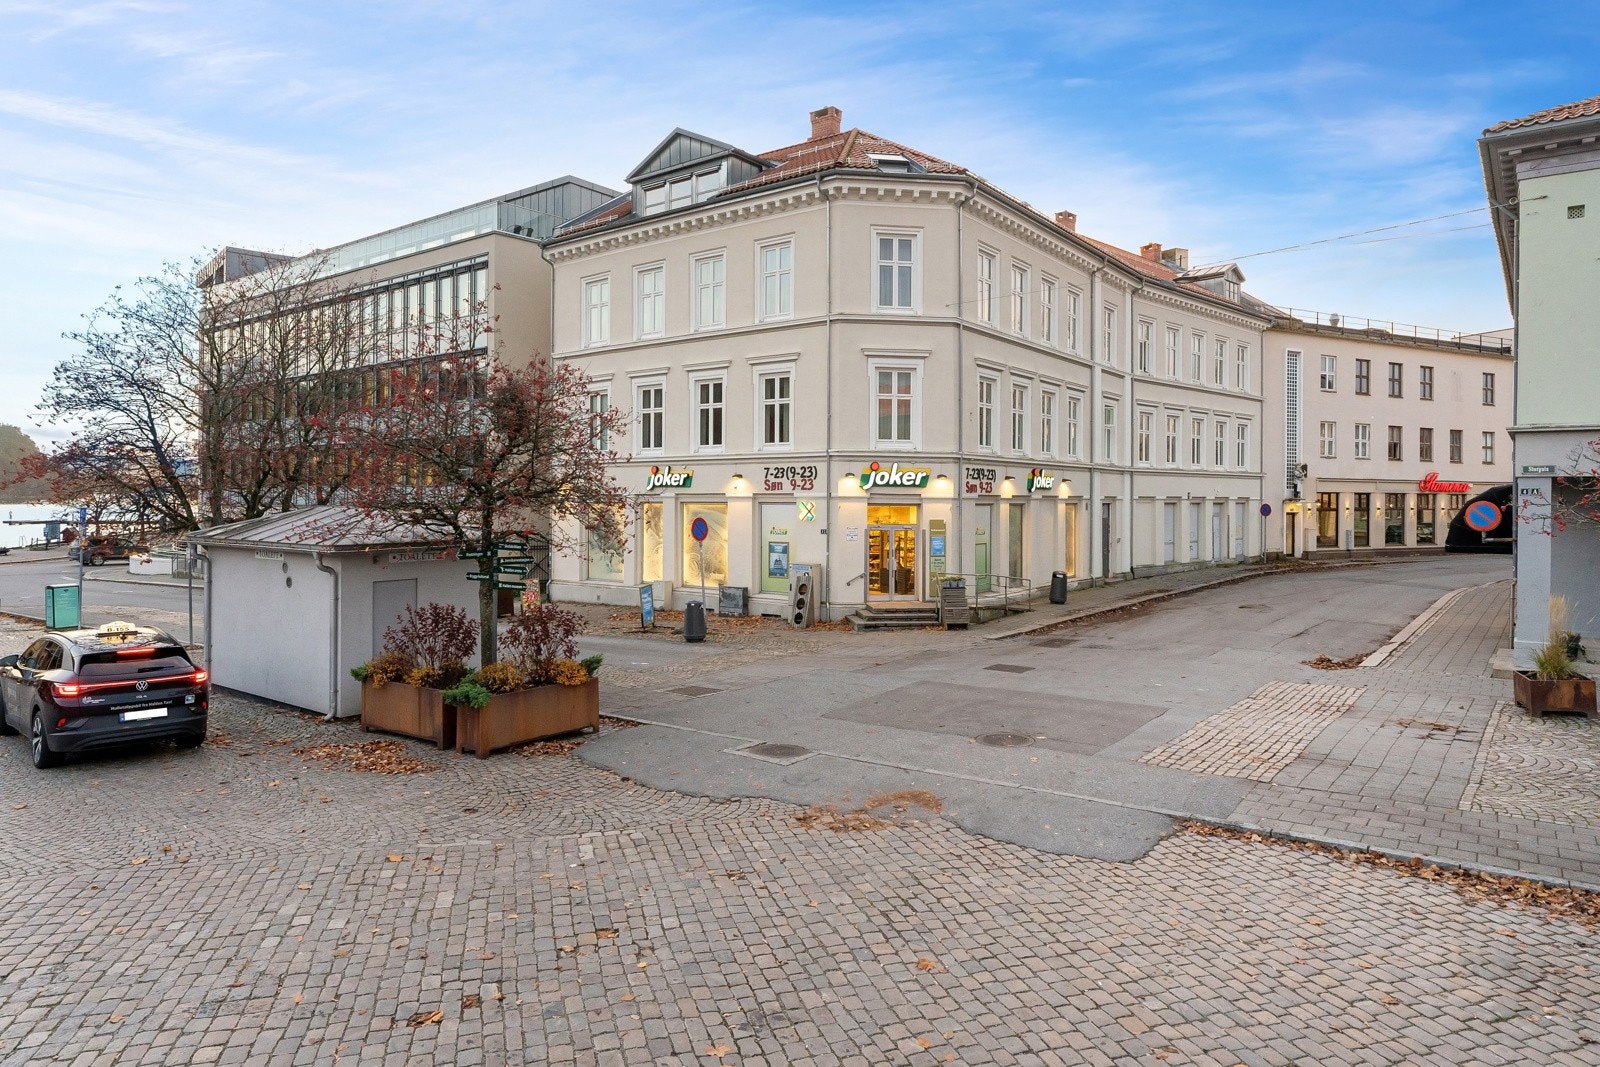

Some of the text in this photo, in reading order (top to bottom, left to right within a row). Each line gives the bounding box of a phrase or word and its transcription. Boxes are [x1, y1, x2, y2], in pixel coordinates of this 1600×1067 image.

[647, 465, 688, 490] joker
[764, 478, 814, 491] Søn 9-23
[860, 461, 927, 490] joker
[965, 481, 993, 494] Søn 9-23
[1029, 468, 1055, 492] joker
